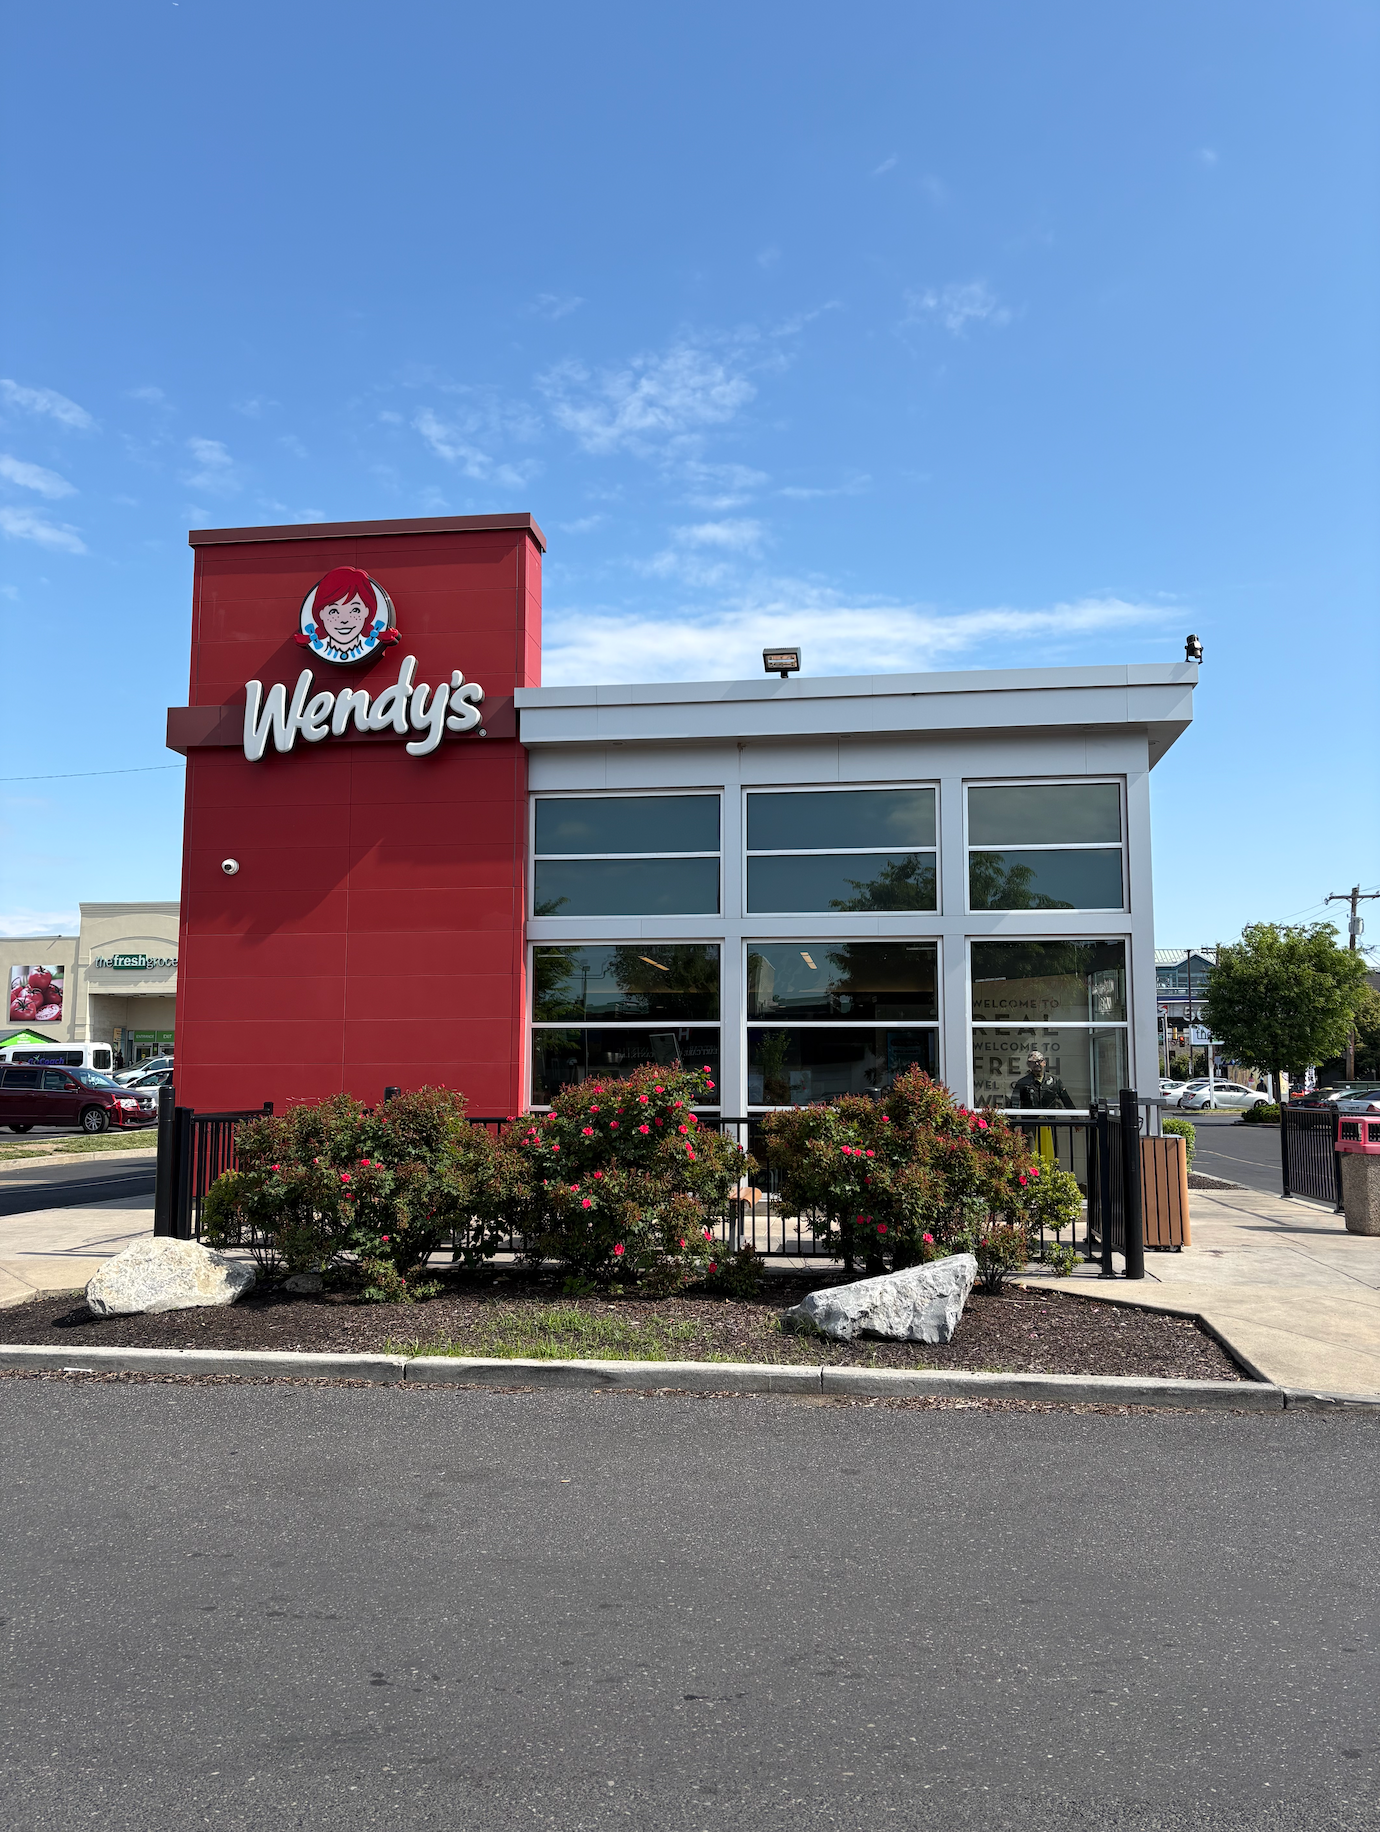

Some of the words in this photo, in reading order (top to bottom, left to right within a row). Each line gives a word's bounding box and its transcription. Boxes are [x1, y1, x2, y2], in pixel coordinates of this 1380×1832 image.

[243, 654, 482, 762] Wendy's
[973, 999, 1037, 1008] WELCOME
[1042, 999, 1059, 1008] TO
[972, 1013, 1059, 1036] REAL
[974, 1042, 1038, 1051] WELCOME
[1042, 1042, 1061, 1051] TO
[973, 1056, 1061, 1075] FREH
